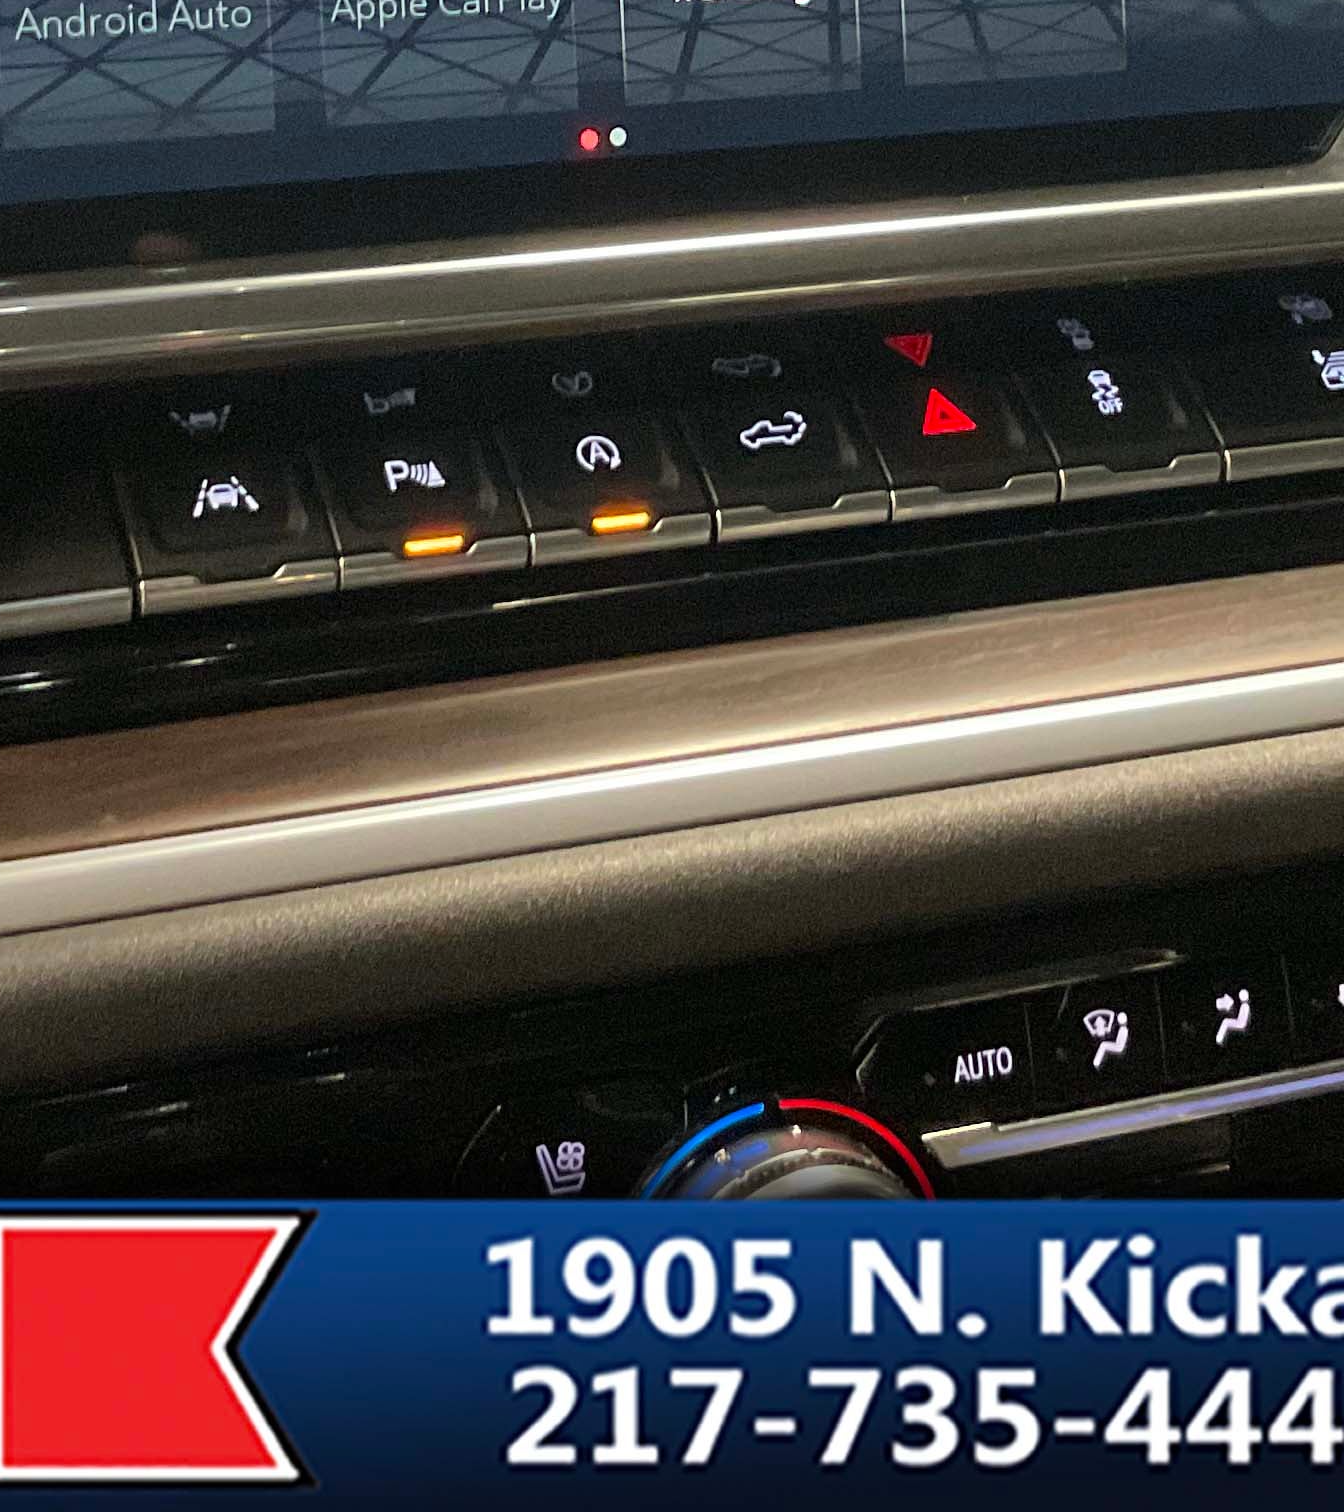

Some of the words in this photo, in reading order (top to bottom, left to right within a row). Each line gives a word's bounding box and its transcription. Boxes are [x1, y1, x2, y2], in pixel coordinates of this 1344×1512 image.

[1097, 397, 1123, 415] OFF
[385, 459, 409, 492] P
[953, 1046, 1013, 1083] AUTO
